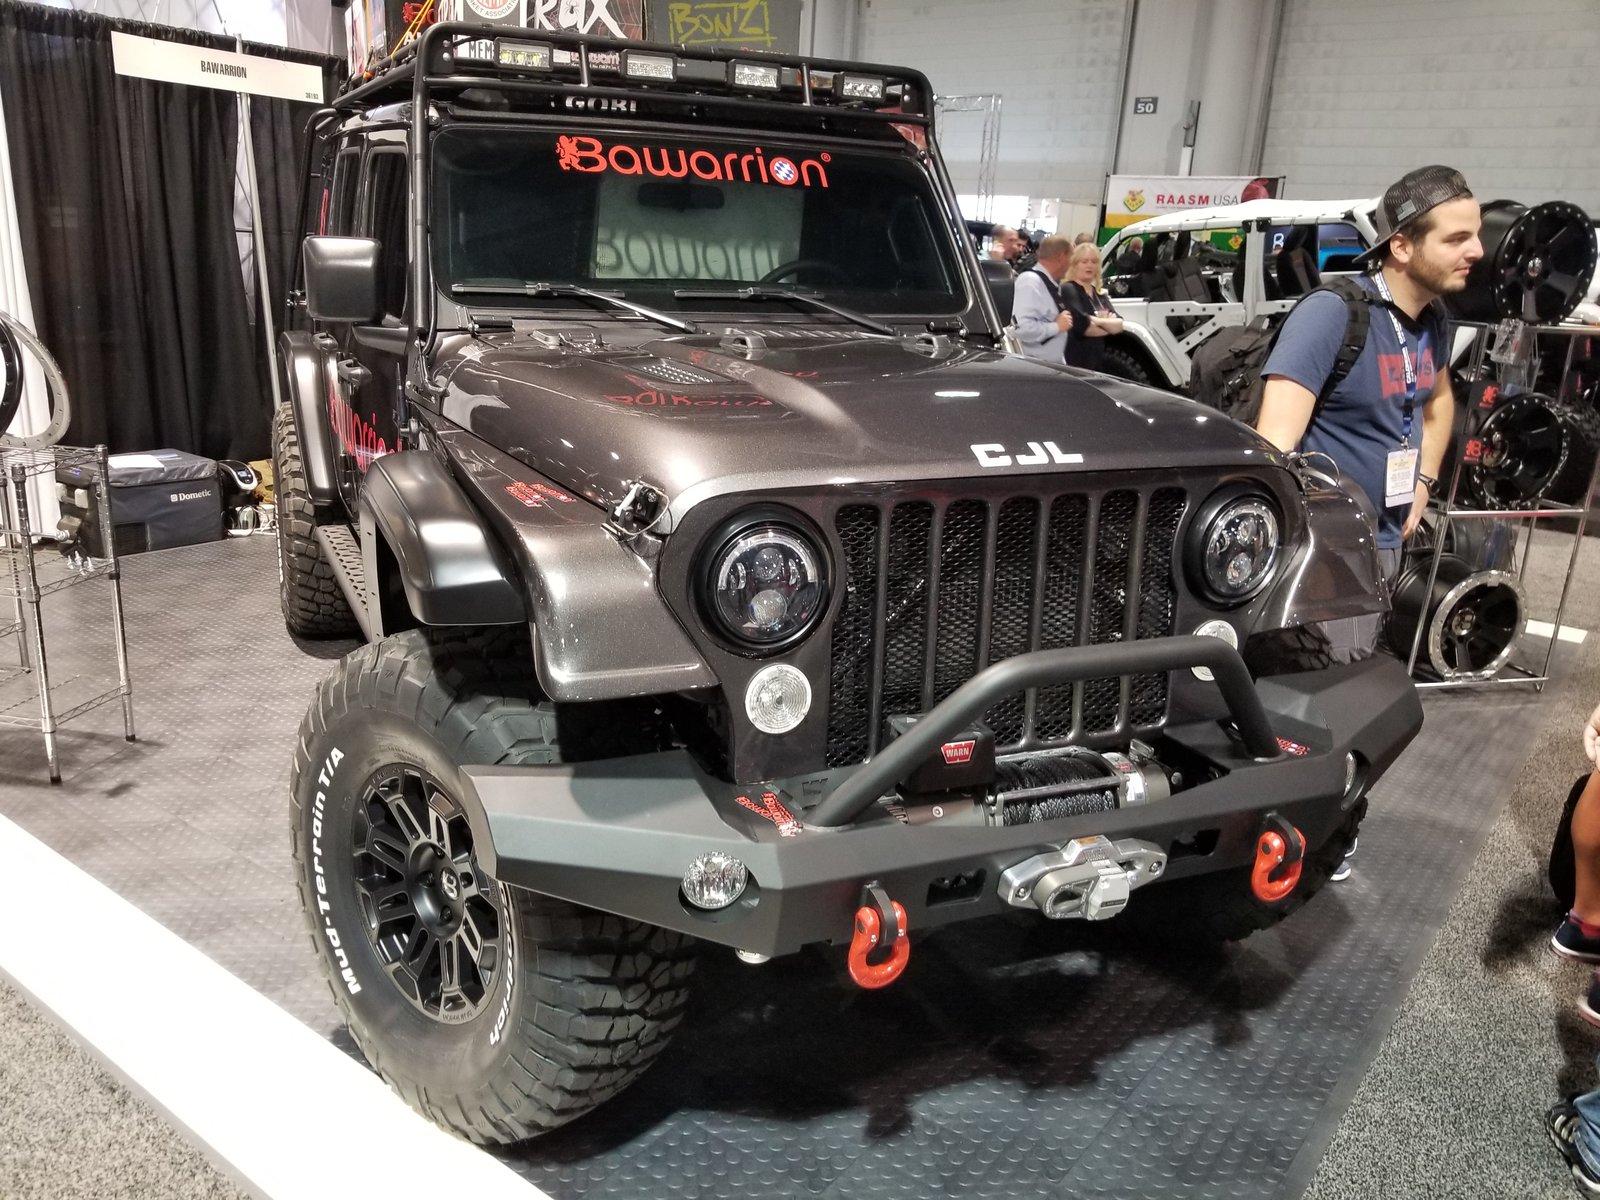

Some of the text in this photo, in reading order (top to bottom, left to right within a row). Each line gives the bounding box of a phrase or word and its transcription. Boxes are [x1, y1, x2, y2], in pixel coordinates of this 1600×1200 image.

[200, 60, 248, 79] BAWARRION
[1136, 102, 1154, 113] 50
[1156, 194, 1210, 206] RAASM
[1213, 195, 1239, 207] USA
[969, 440, 1085, 468] CJL
[178, 489, 212, 502] Dometic
[945, 747, 970, 758] WARN
[318, 746, 345, 787] T/A
